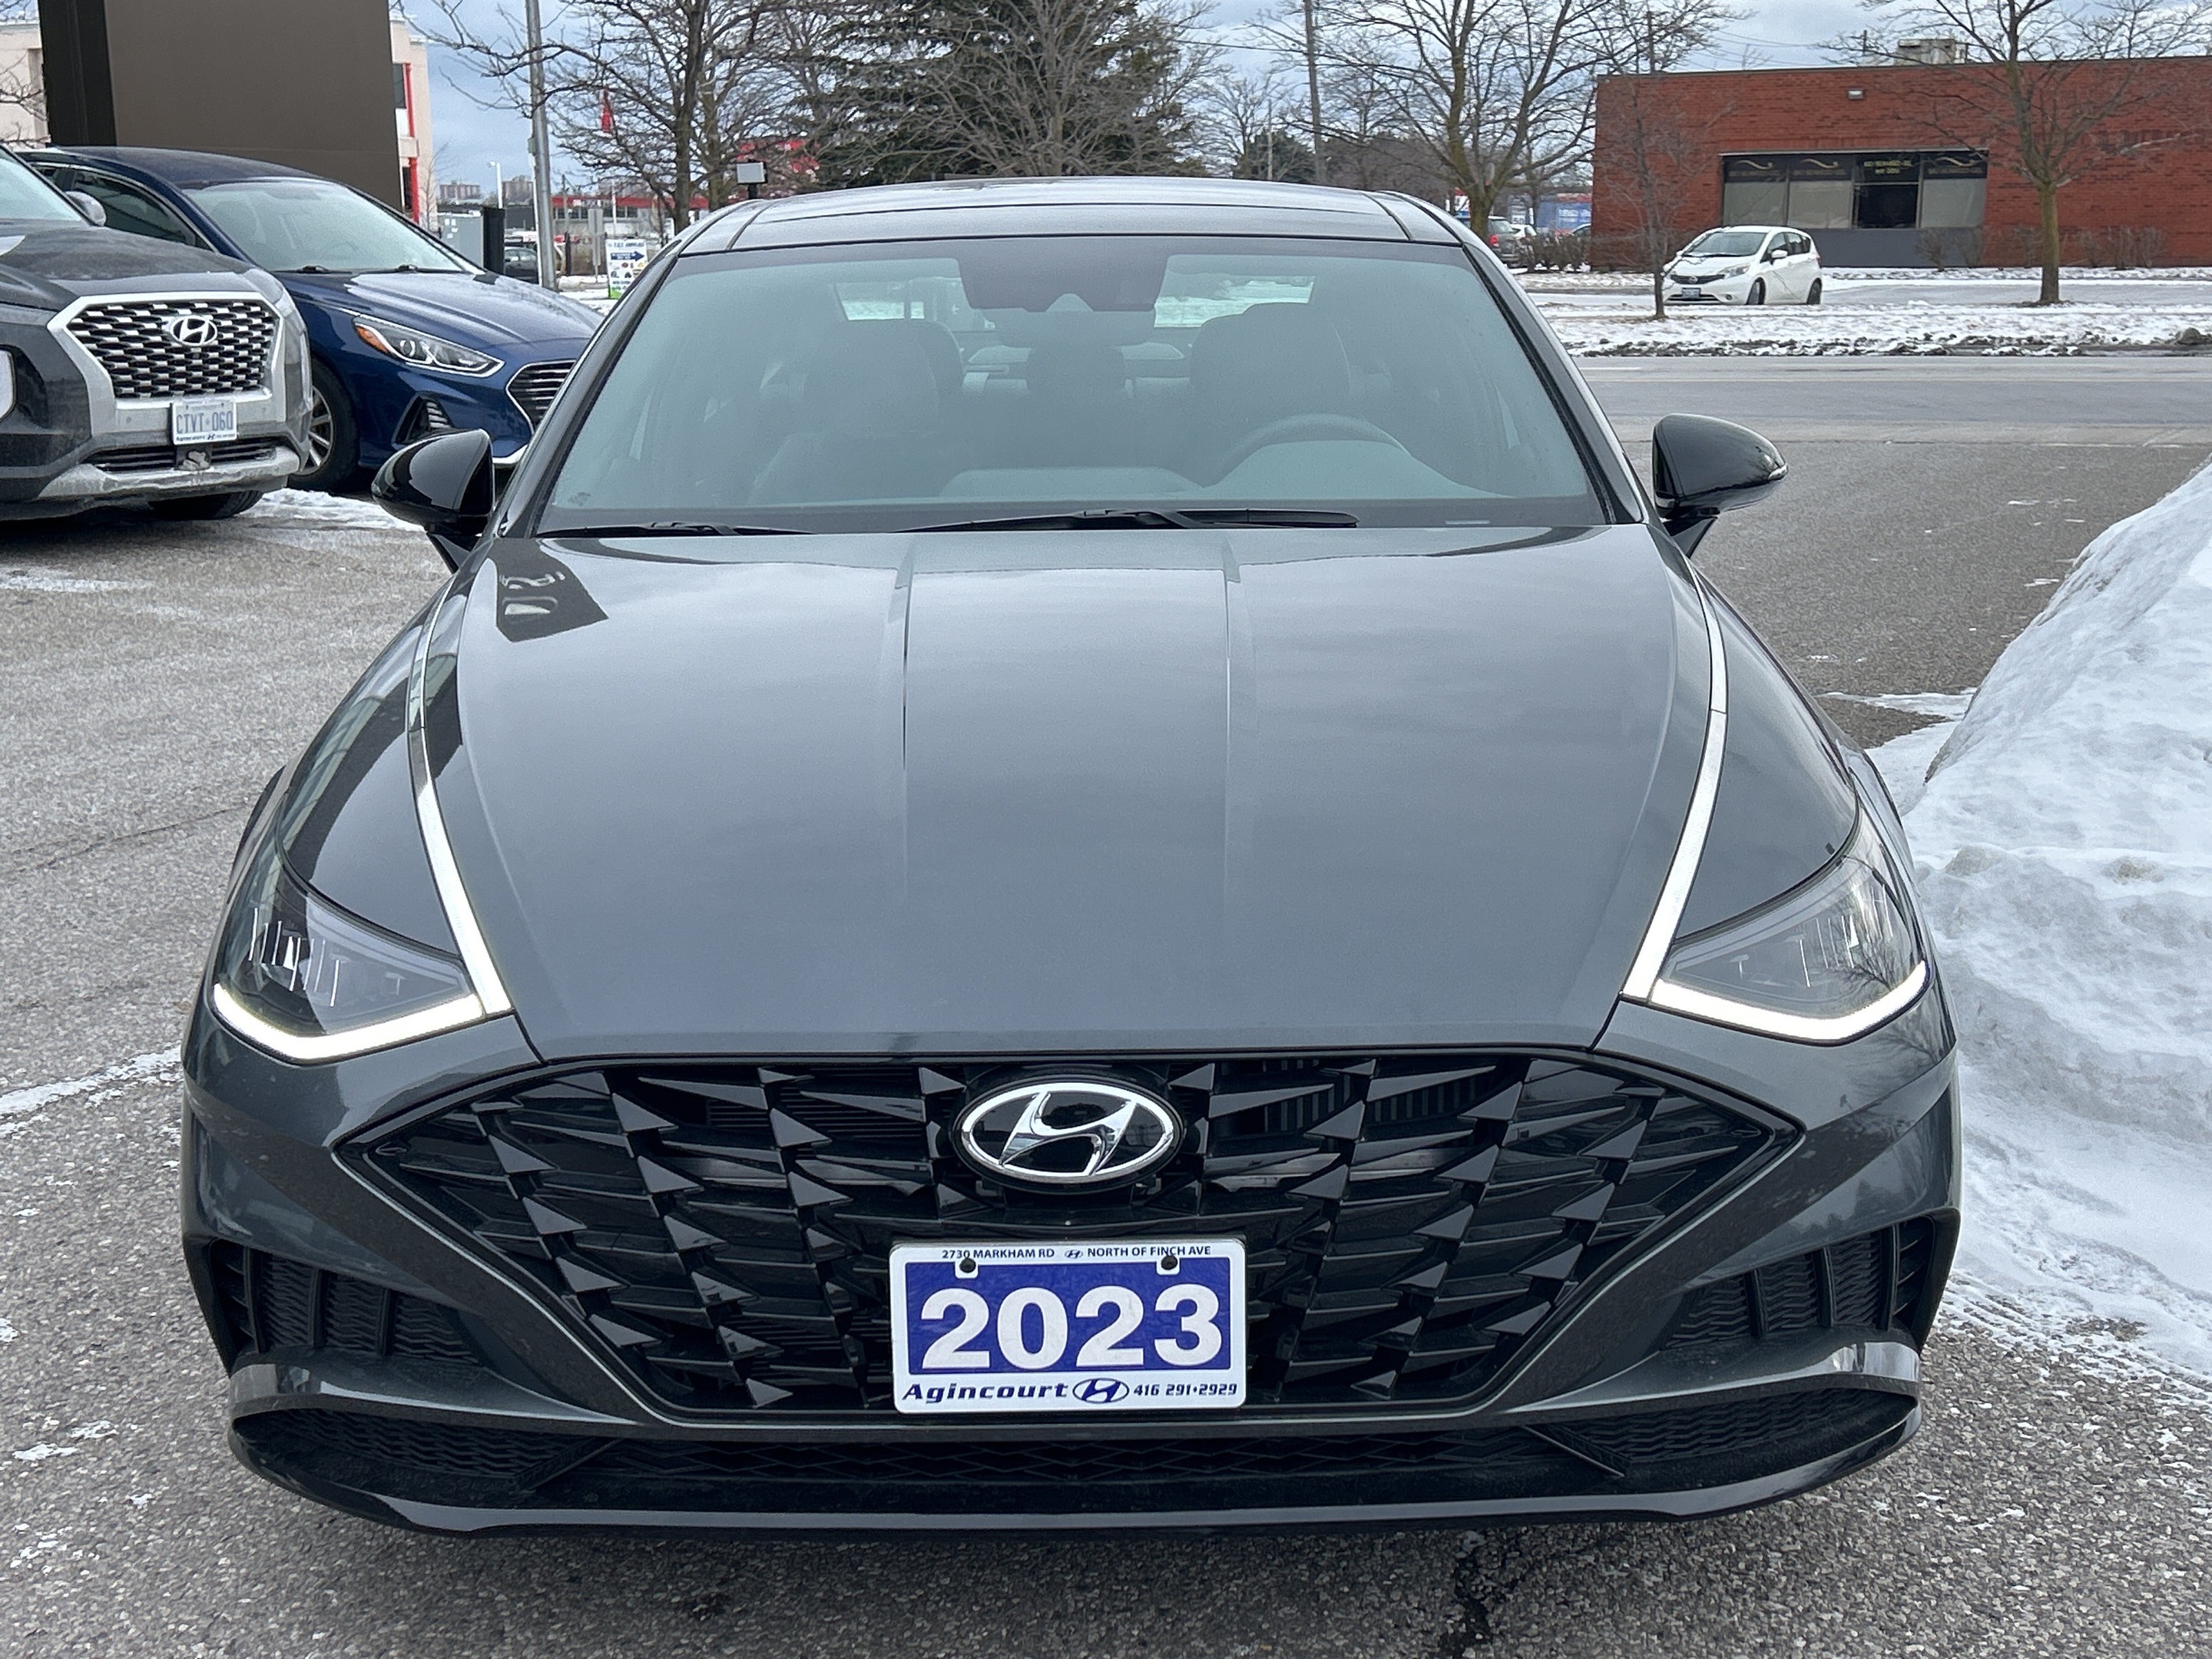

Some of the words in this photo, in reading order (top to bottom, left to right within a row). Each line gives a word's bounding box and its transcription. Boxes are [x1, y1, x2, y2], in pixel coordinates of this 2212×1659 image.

[942, 1250, 970, 1259] 2730
[973, 1249, 1035, 1258] MARKHAM
[1038, 1248, 1055, 1258] RD
[1088, 1247, 1128, 1257] NORTH
[1131, 1247, 1147, 1257] OF
[1150, 1246, 1186, 1256] FINCH
[1188, 1245, 1211, 1255] AVE
[921, 1283, 1222, 1370] 2023
[902, 1382, 1068, 1403] Agincourt
[1134, 1383, 1160, 1396] 416
